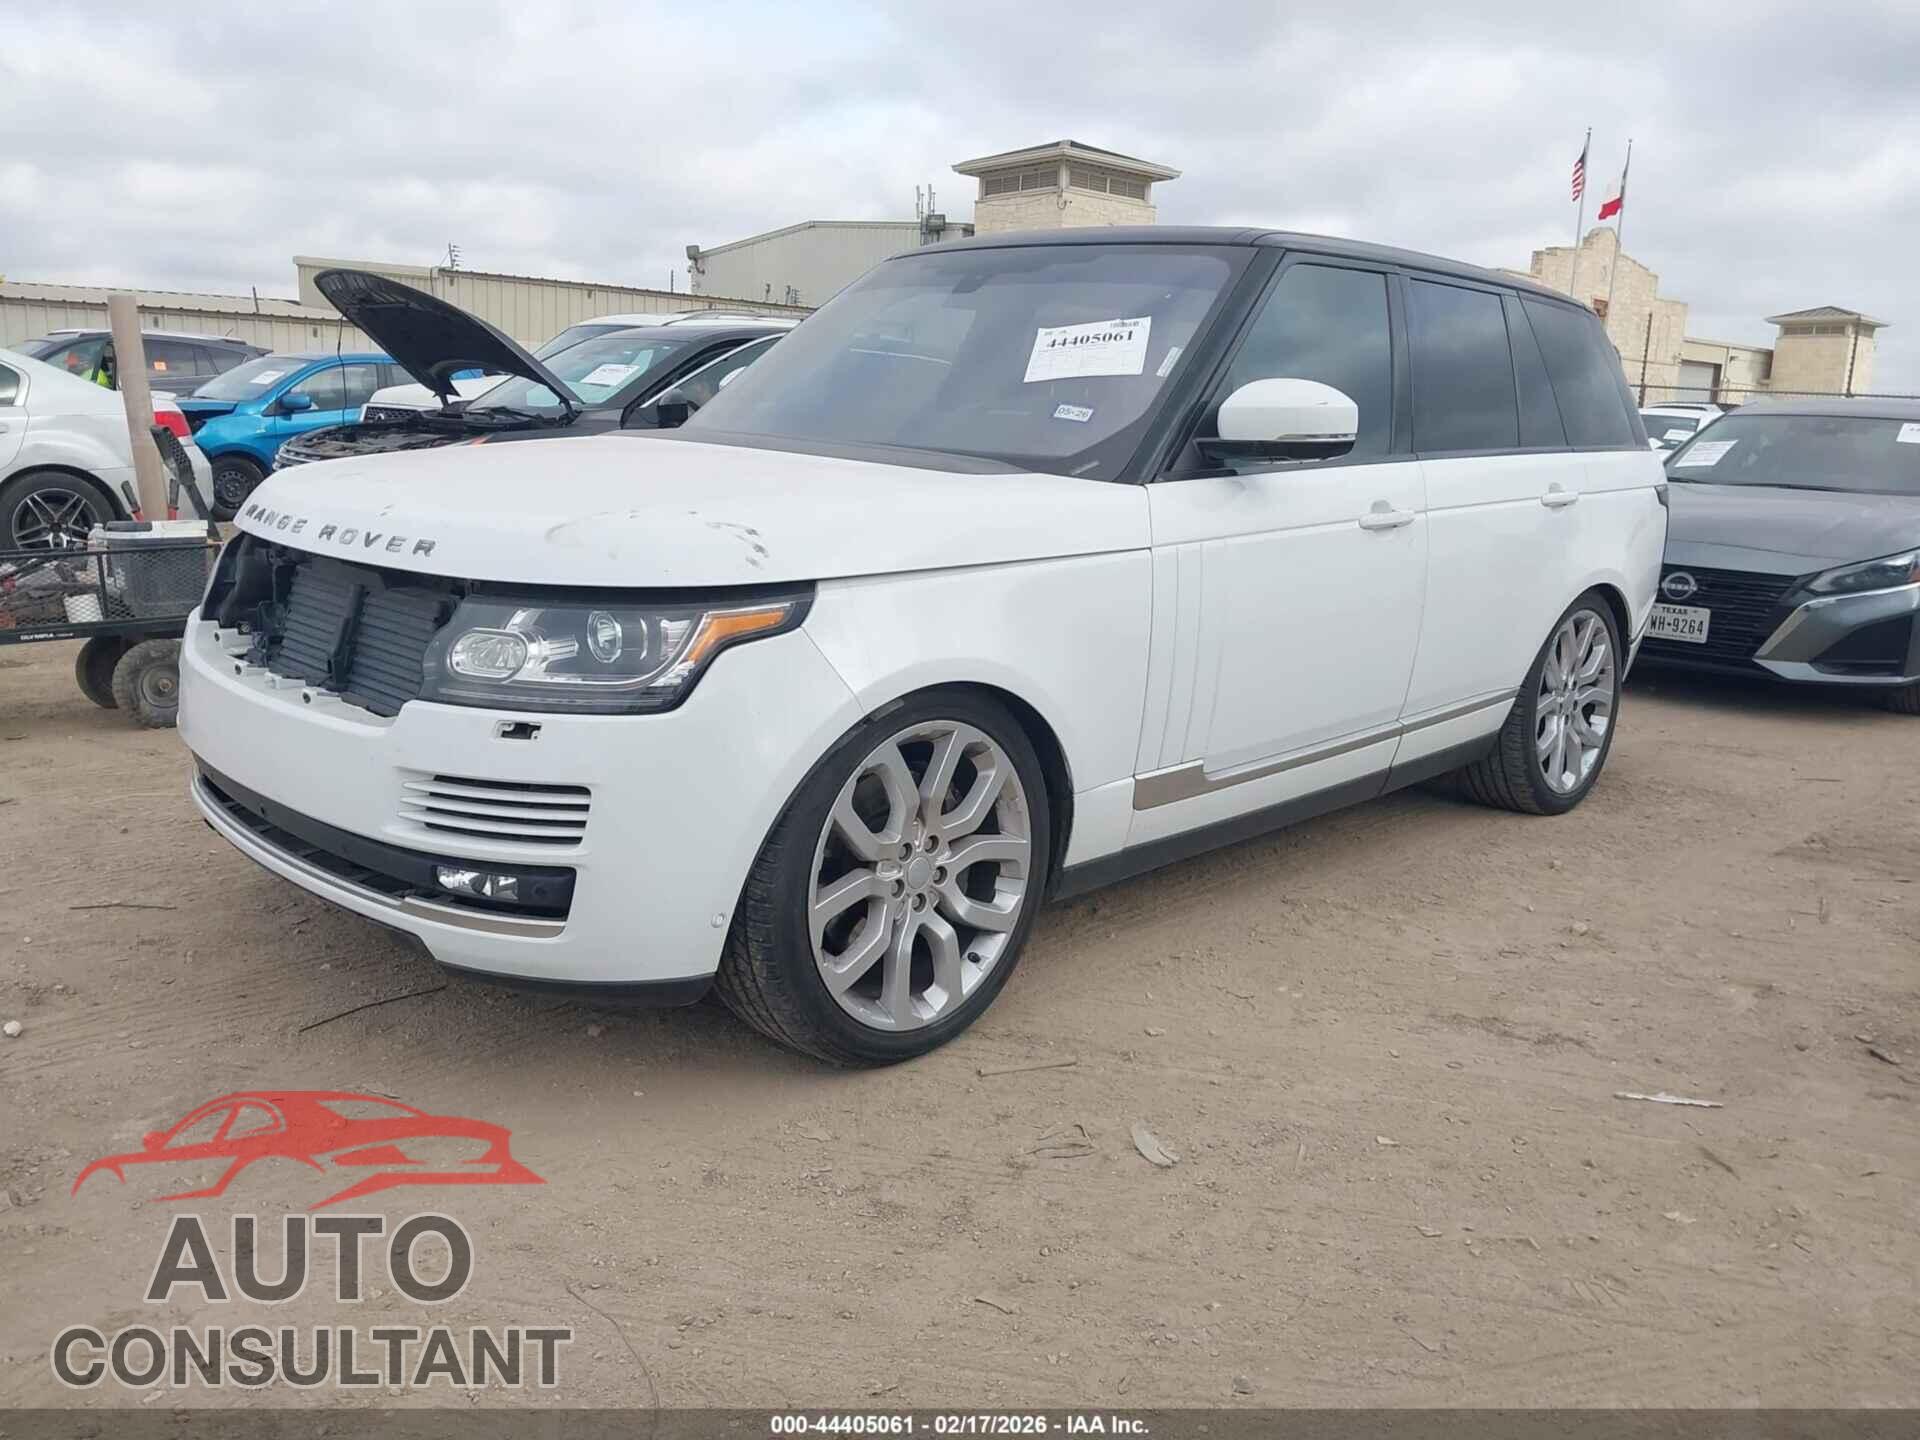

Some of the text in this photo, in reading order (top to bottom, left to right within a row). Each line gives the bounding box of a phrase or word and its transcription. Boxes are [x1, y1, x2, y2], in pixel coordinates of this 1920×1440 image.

[1046, 330, 1133, 348] 44405061
[245, 504, 436, 557] RANGE ROVER
[1661, 606, 1688, 614] TEXAS
